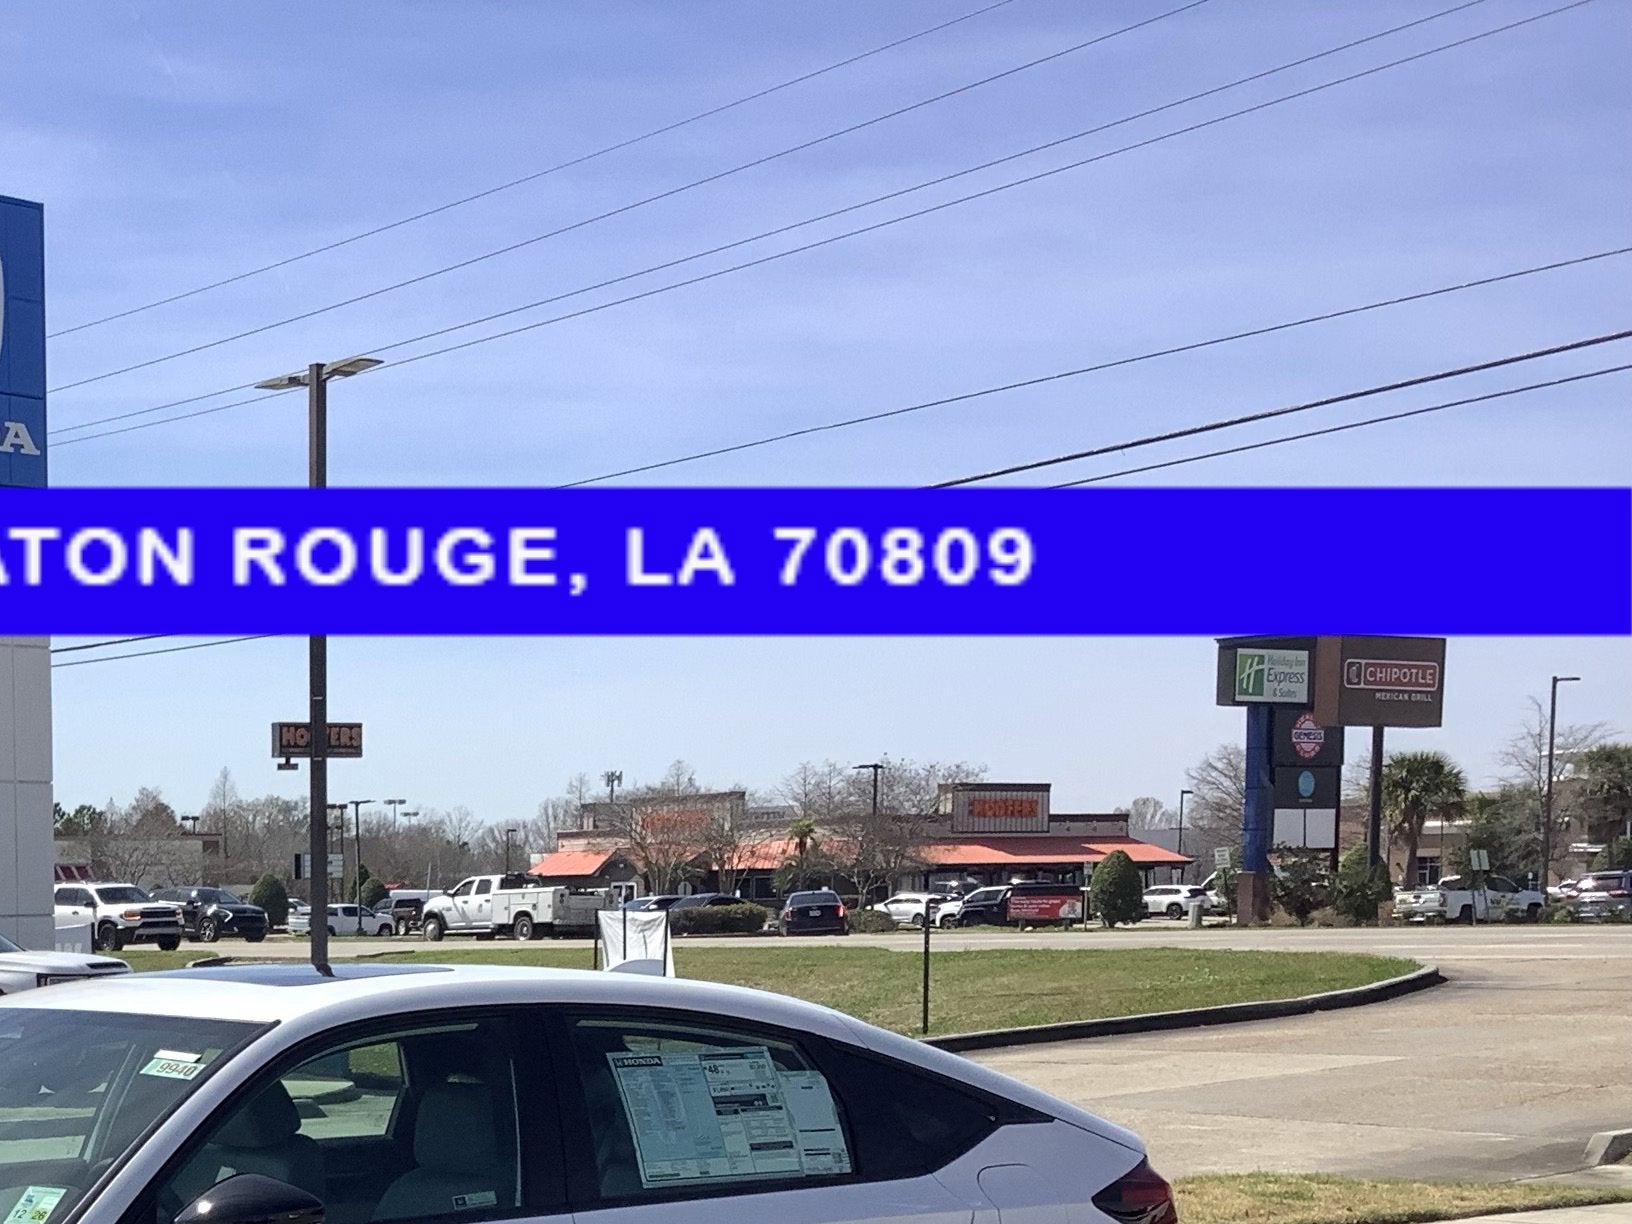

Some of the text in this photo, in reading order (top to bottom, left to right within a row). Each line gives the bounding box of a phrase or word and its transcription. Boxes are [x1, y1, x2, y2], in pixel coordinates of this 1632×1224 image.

[1268, 654, 1294, 669] Holiday
[1267, 667, 1305, 686] Express
[1366, 666, 1434, 684] CHIPOTLE
[1279, 688, 1296, 698] Suites
[1375, 692, 1432, 702] MEXICAN GRILL
[281, 726, 361, 746] HOERS
[1294, 731, 1323, 741] GENESIS
[623, 1057, 661, 1066] HONDA
[156, 1062, 198, 1077] 9940
[13, 1209, 48, 1221] 12 26
